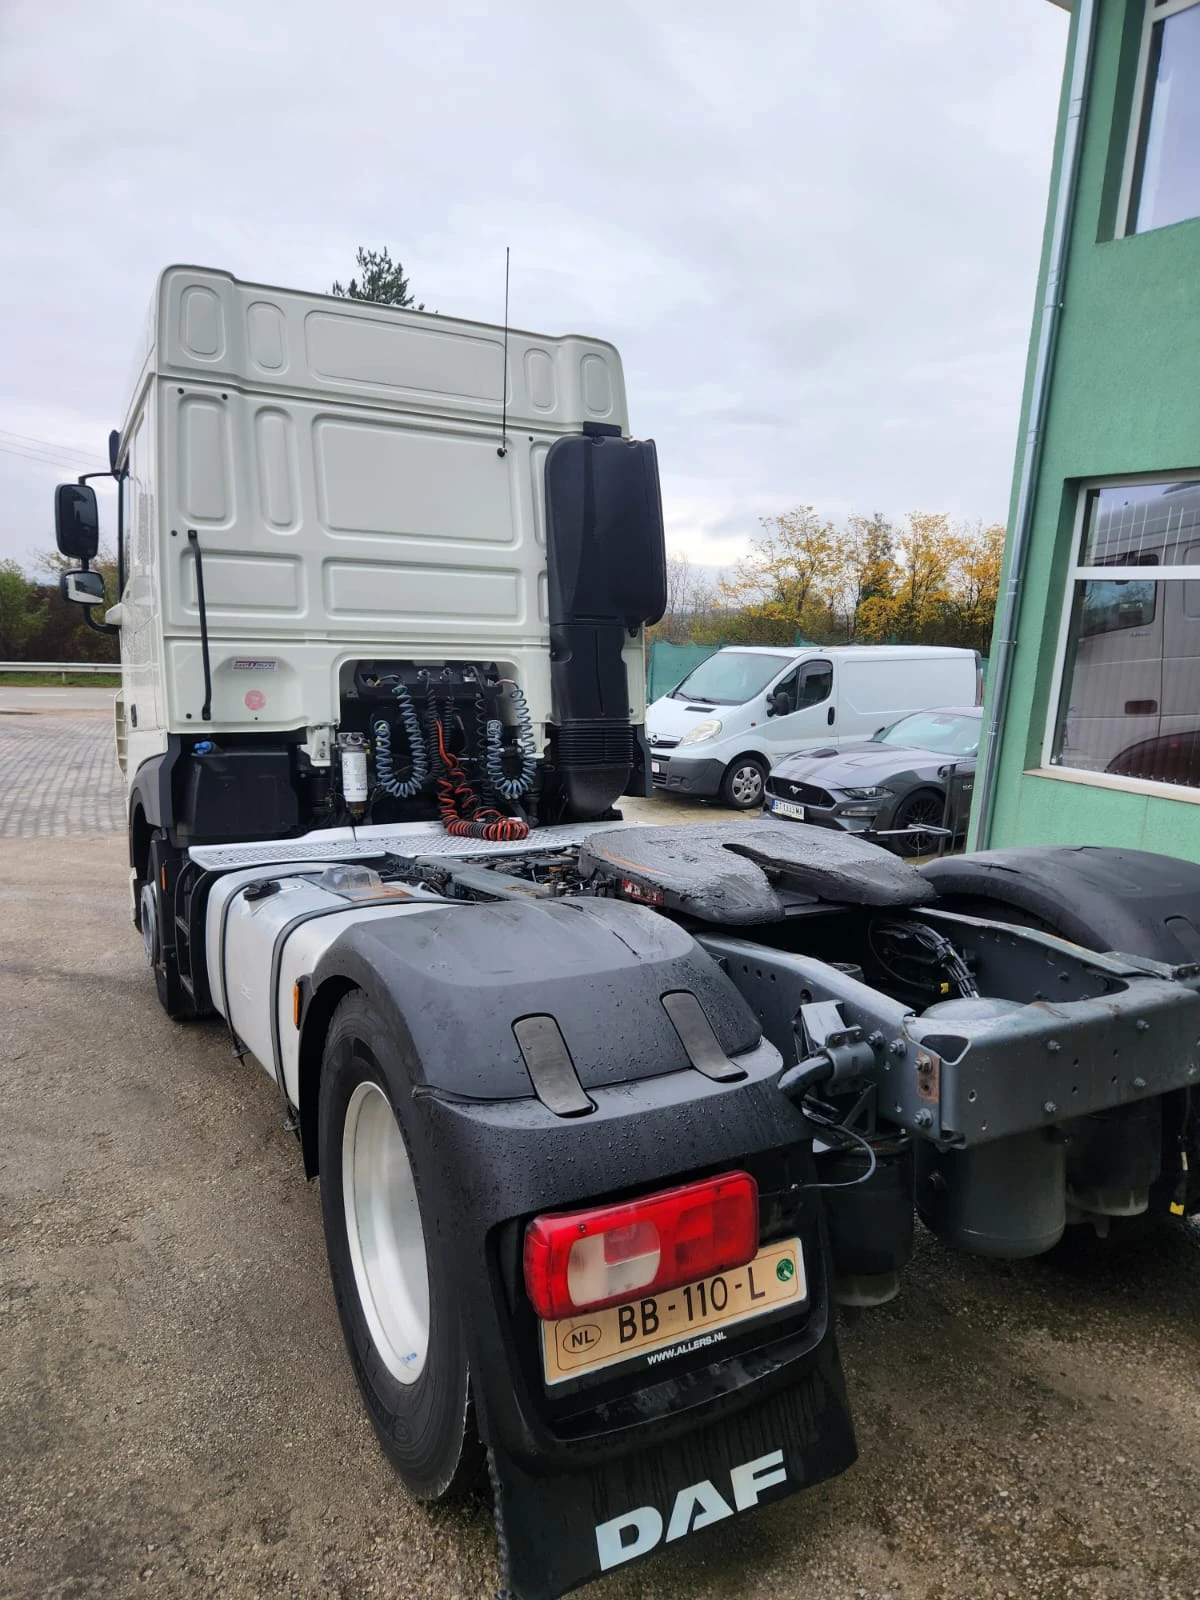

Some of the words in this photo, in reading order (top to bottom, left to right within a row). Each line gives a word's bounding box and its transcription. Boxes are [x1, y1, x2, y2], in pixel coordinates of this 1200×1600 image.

[571, 1330, 595, 1348] NL
[647, 1331, 727, 1366] WWW.ALLERS.NL
[595, 1448, 787, 1571] DAF
